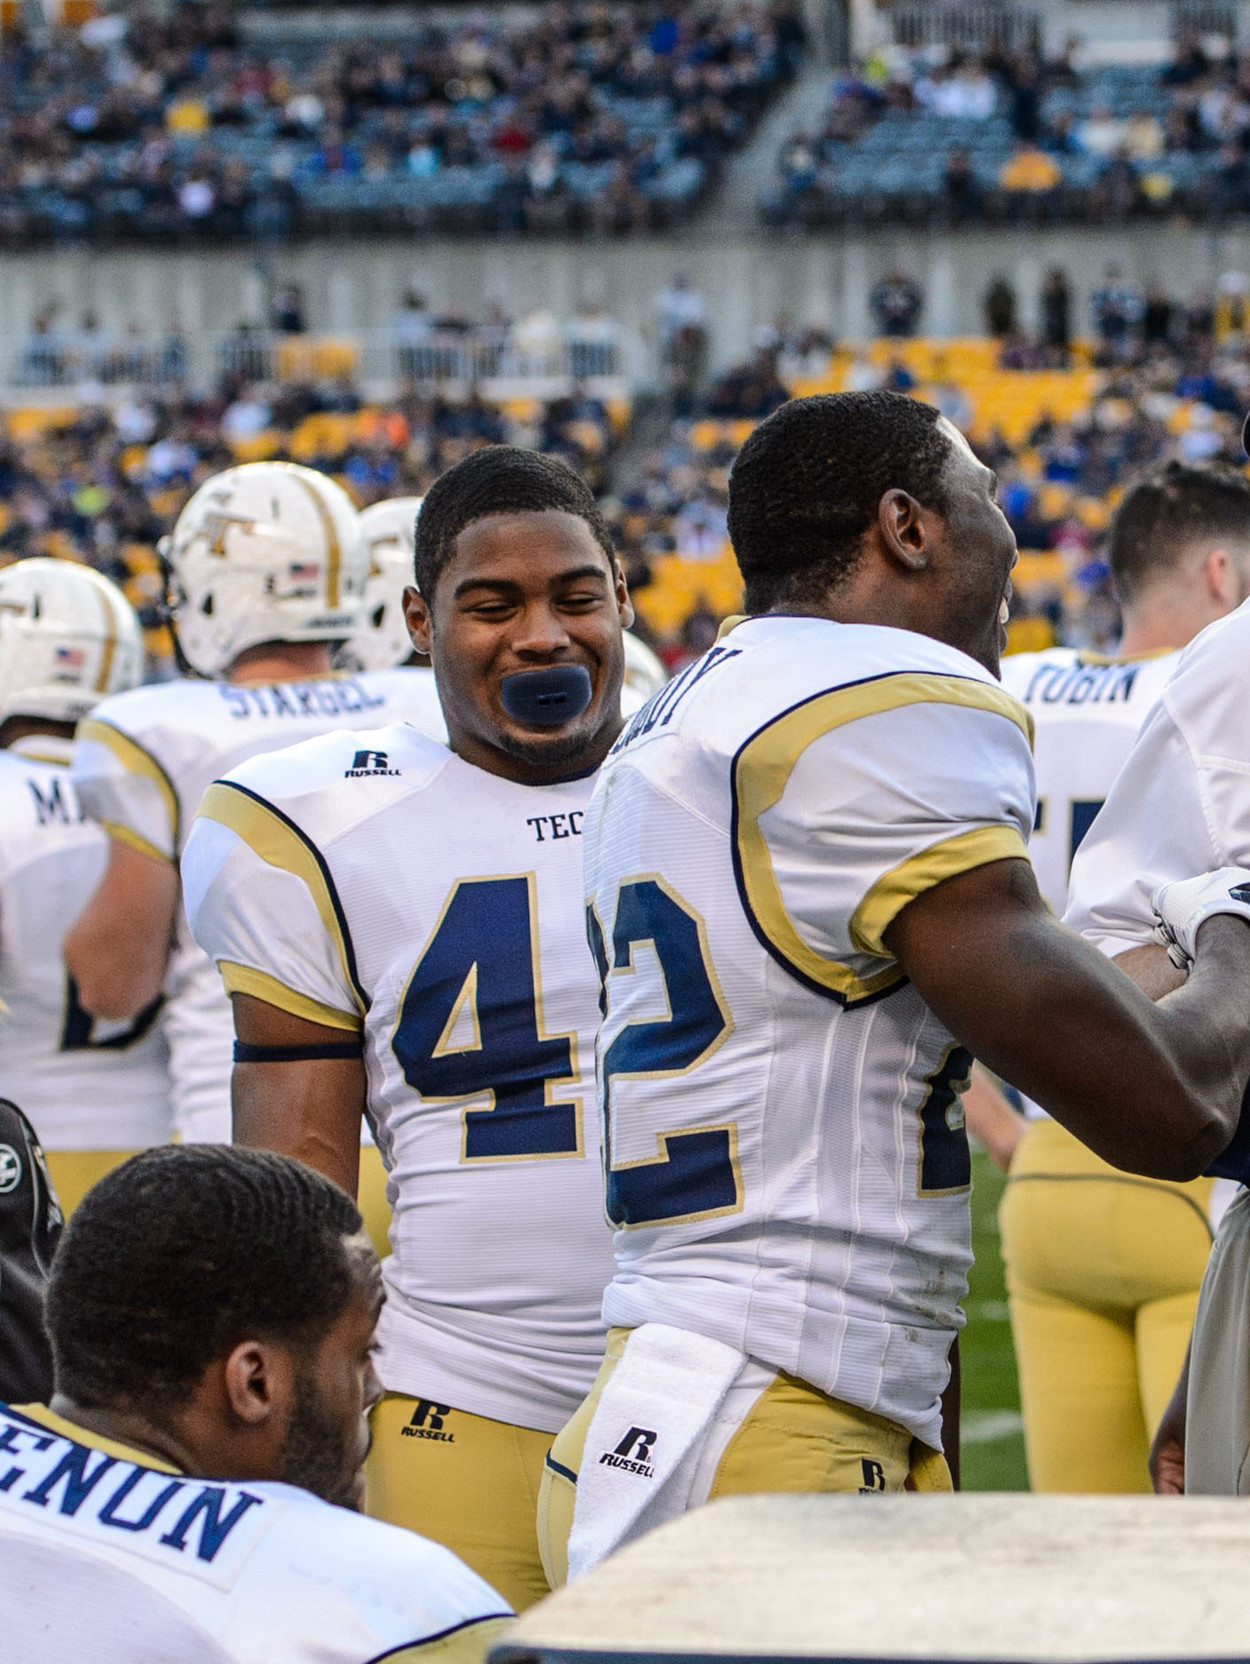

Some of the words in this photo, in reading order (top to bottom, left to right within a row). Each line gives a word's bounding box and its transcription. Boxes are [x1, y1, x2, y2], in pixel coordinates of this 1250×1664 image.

[344, 767, 402, 779] RUSSELL
[526, 810, 588, 842] TEC
[400, 1425, 456, 1444] RUSSELL
